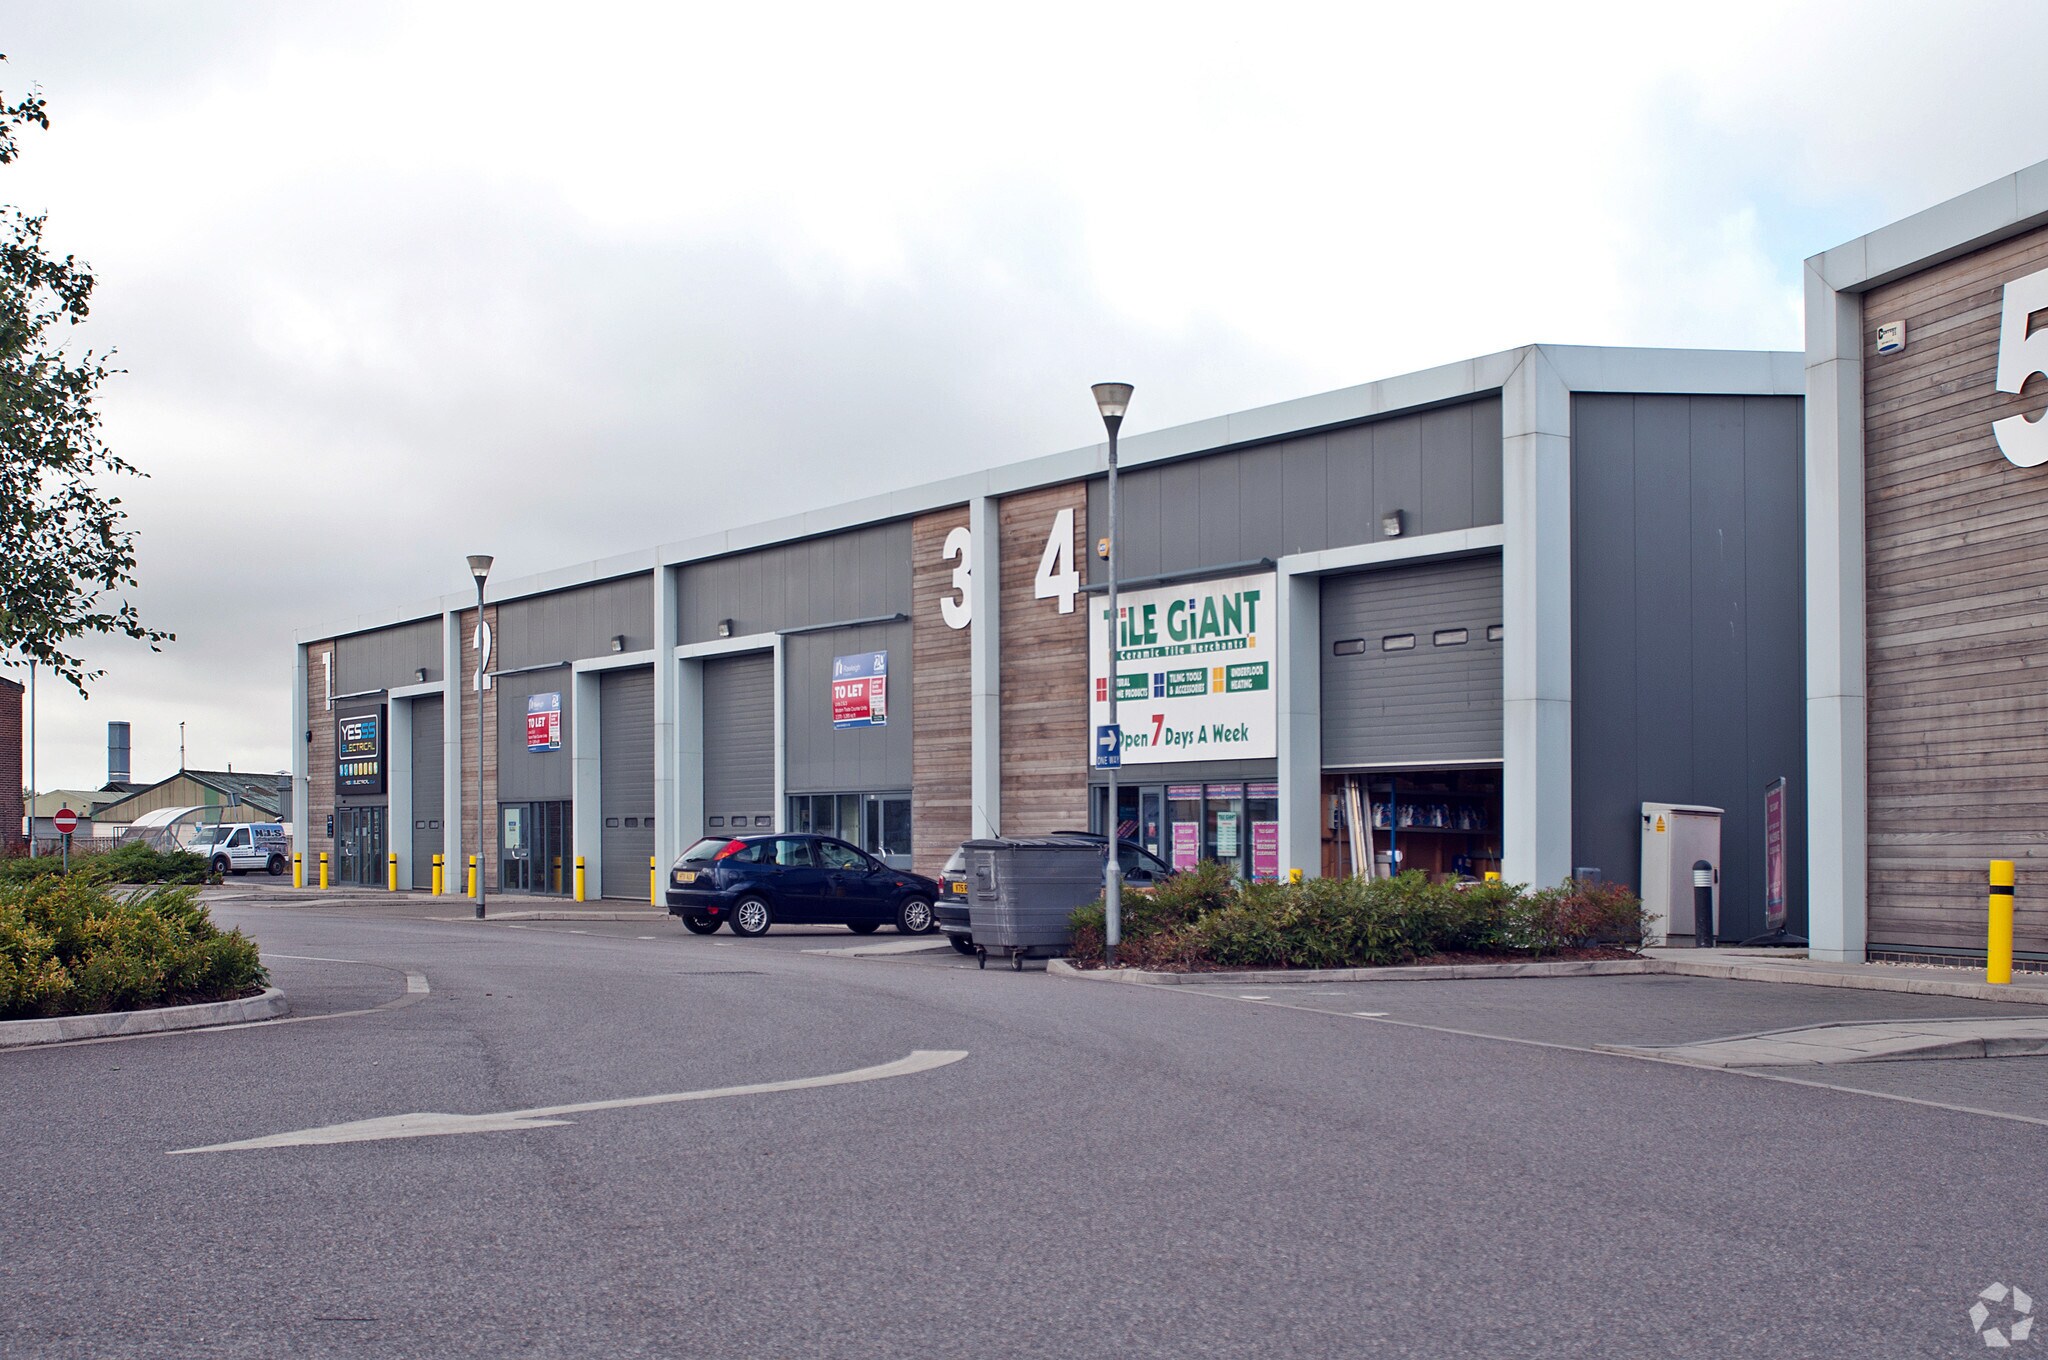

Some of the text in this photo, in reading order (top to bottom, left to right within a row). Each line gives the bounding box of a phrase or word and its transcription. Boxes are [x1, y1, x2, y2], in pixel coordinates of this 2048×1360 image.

[1992, 267, 2048, 468] 5
[1034, 507, 1080, 614] 4
[940, 526, 972, 630] 3
[472, 620, 492, 691] 2
[1120, 639, 1244, 660] Ceramic Tile Merchants
[1169, 671, 1203, 683] TILING TOOLS
[1230, 665, 1264, 678] UNDERFLOOR
[322, 651, 331, 711] 1
[1175, 683, 1205, 694] ACCESSORIES
[1230, 679, 1253, 690] HEATING
[834, 685, 846, 699] TO
[847, 683, 864, 698] LET
[341, 721, 376, 741] YESSS
[528, 717, 535, 729] TO
[535, 716, 546, 728] LET
[1151, 714, 1165, 746] 7
[1165, 727, 1194, 749] Days
[1197, 725, 1208, 744] A
[1213, 722, 1249, 743] Week
[341, 741, 376, 753] ELECTRICAL
[1097, 755, 1120, 766] ONE WAY
